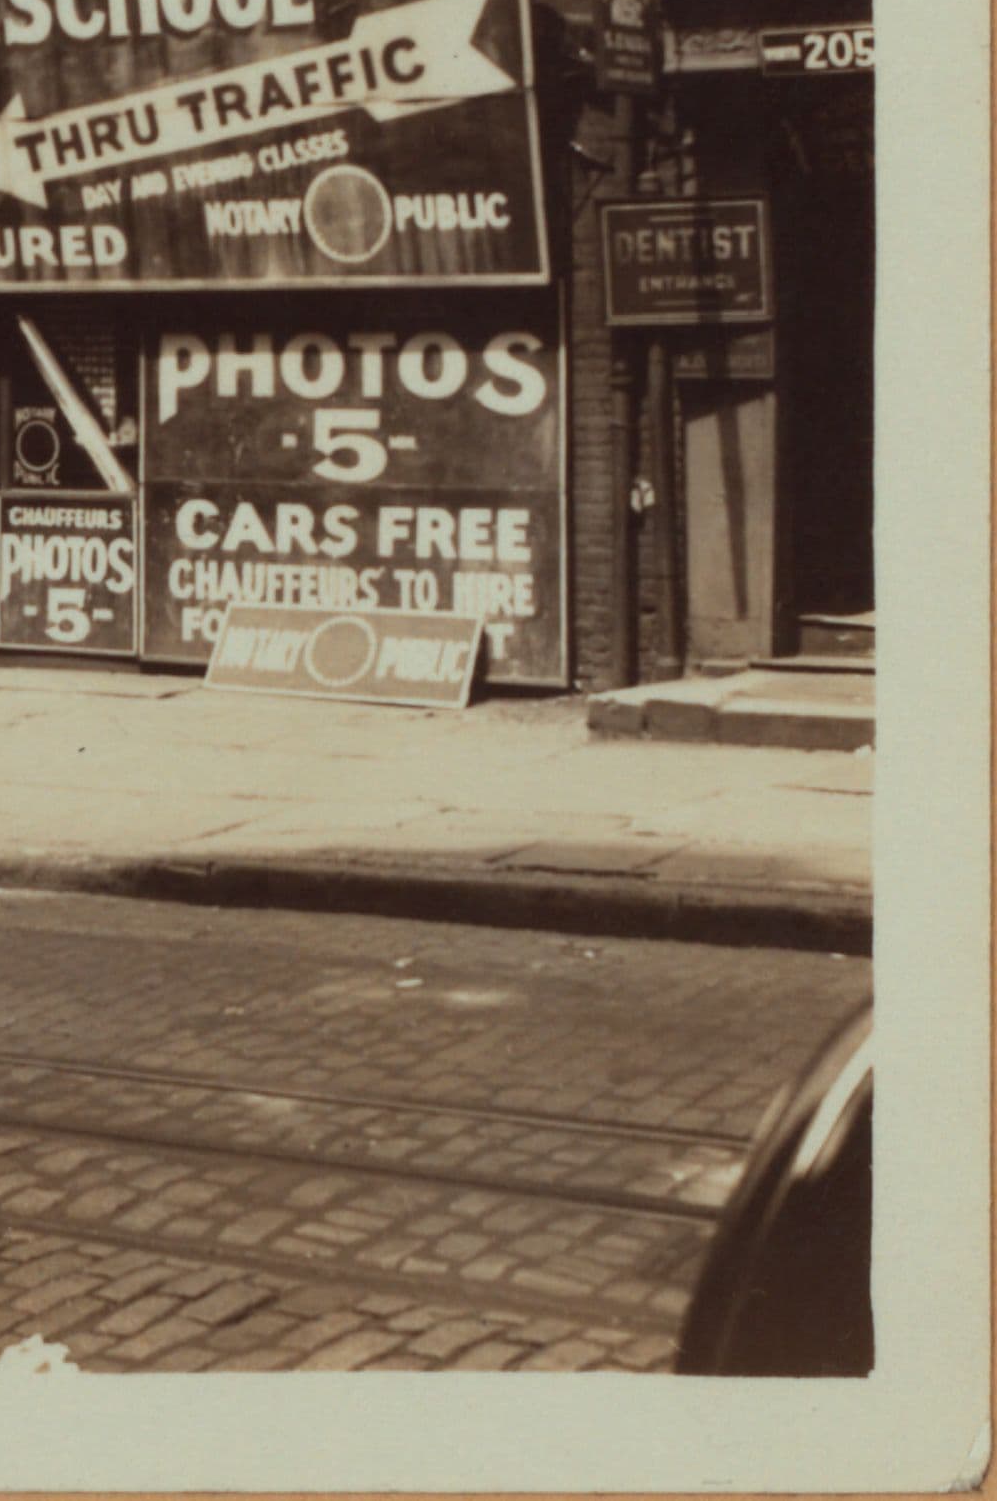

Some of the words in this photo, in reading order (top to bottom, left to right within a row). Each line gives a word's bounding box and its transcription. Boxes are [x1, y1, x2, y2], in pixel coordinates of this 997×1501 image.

[803, 29, 875, 70] 205
[13, 106, 161, 175] THRU
[176, 36, 427, 135] TRAFFIC
[81, 176, 124, 212] DAY
[257, 130, 351, 173] CLASSES
[206, 197, 304, 238] NOTARY
[393, 191, 511, 232] PUBLIC
[616, 224, 757, 266] DENTIST
[157, 332, 549, 425] PHOTOS
[8, 506, 123, 531] CHAUFFEURS
[174, 498, 360, 559] CARS
[376, 505, 532, 563] FREE
[0, 532, 135, 603] PHOTOS
[393, 568, 439, 613] TO
[452, 571, 536, 618] HIRE
[180, 606, 230, 644] FO
[374, 635, 471, 685] PUBLIC
